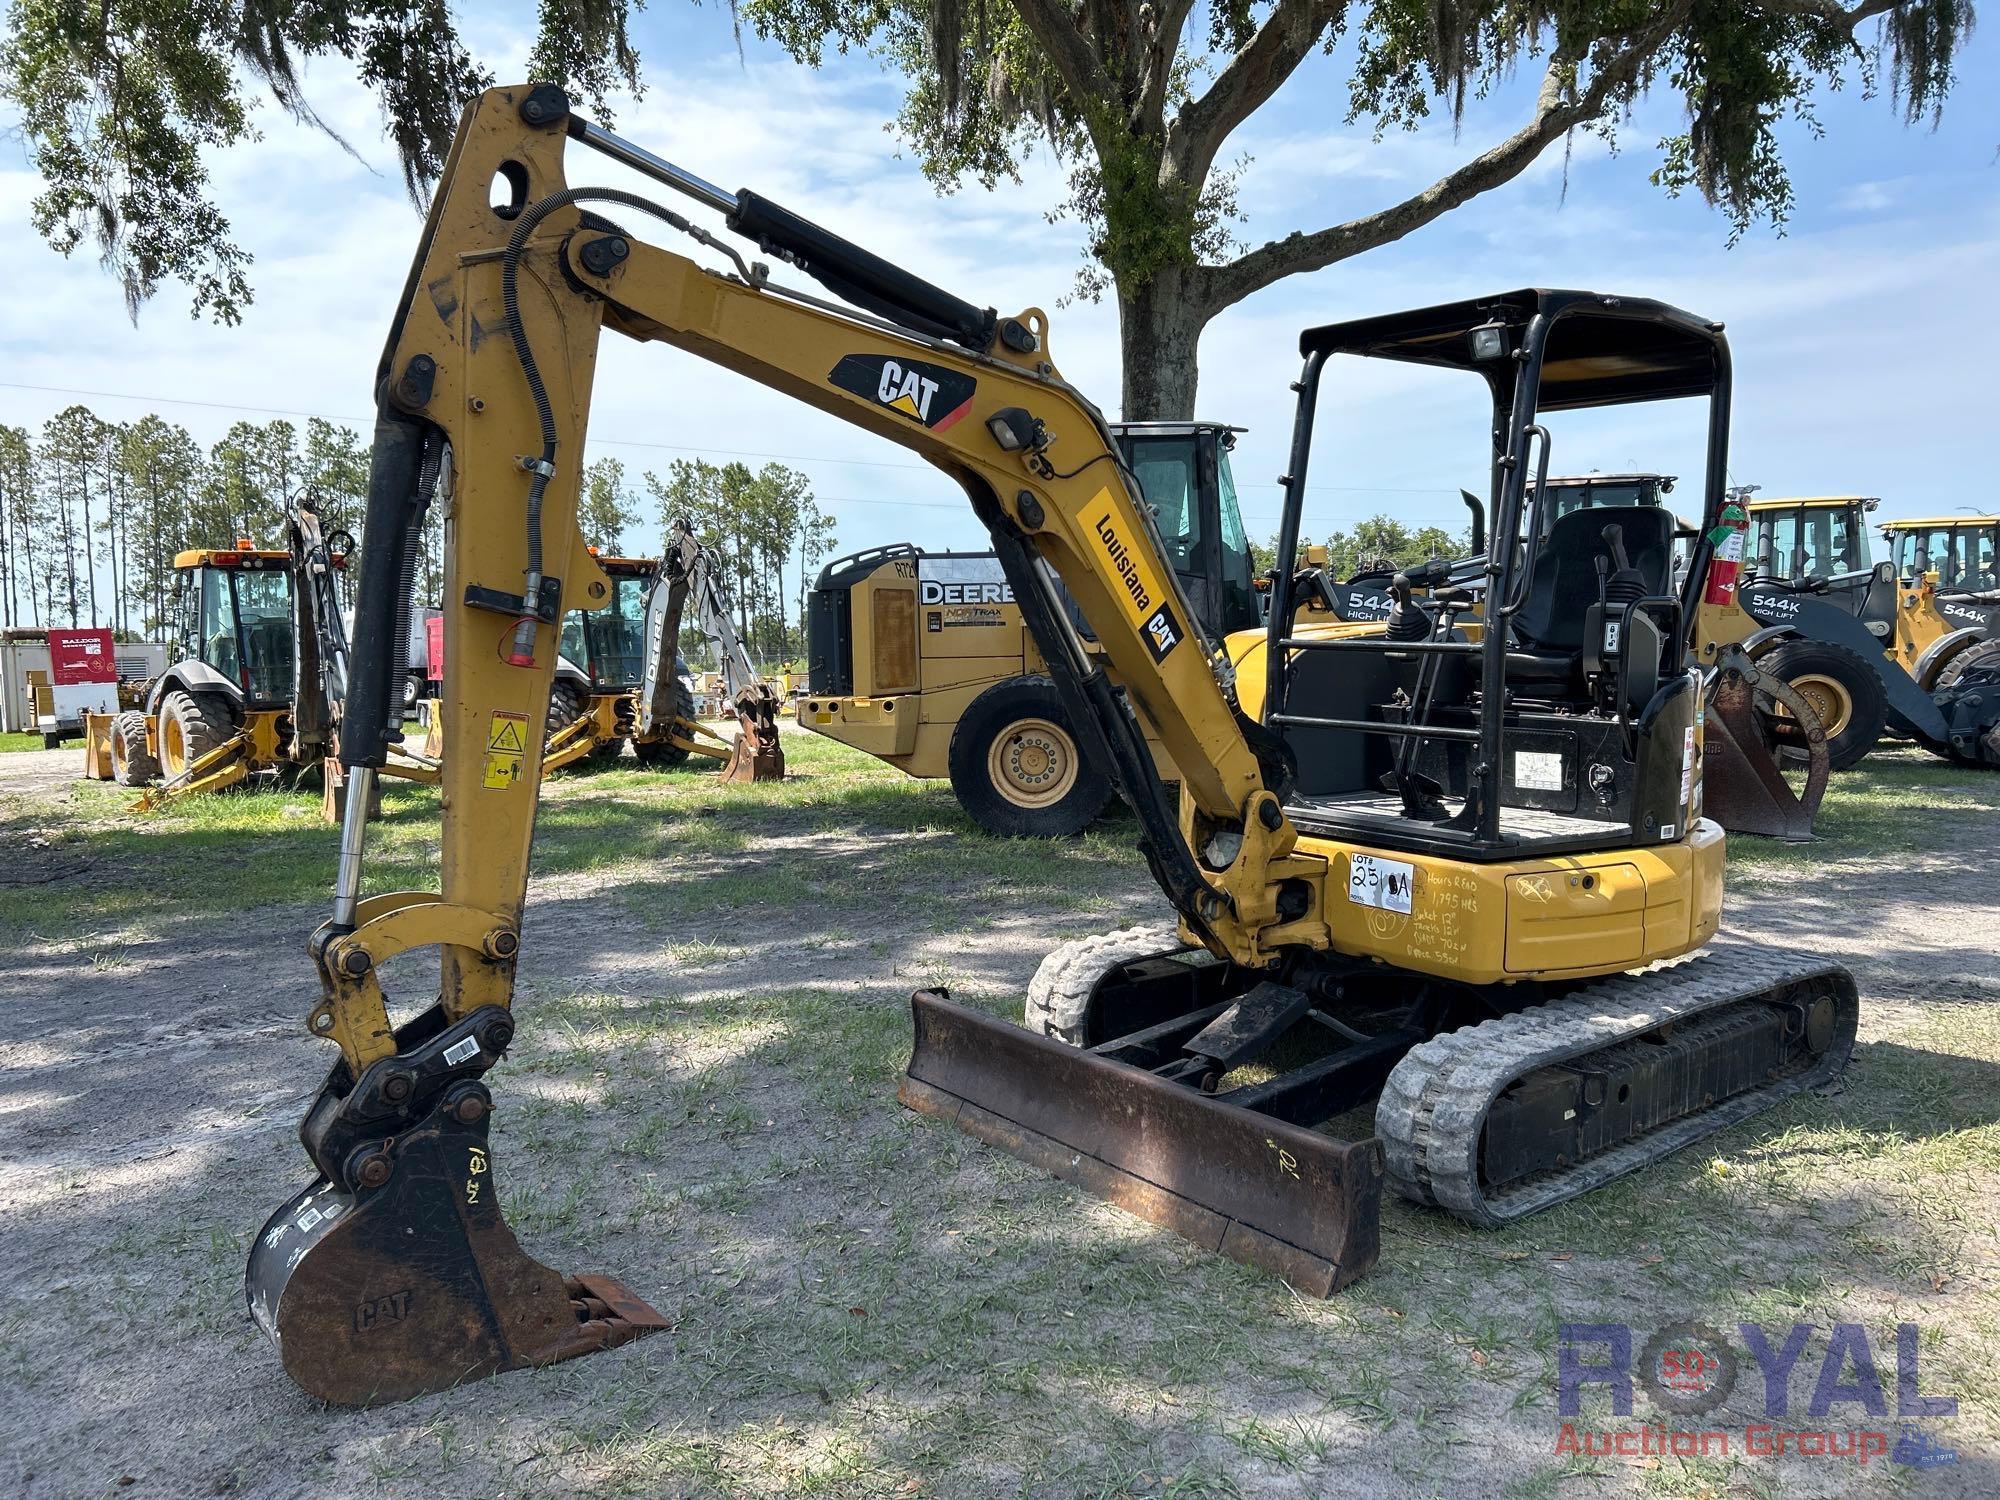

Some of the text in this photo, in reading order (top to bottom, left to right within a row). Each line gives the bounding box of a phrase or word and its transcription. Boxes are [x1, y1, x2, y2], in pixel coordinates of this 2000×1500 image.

[878, 360, 939, 422] CAT
[1095, 513, 1150, 612] Louisiana
[921, 582, 1017, 604] DEERE
[1349, 592, 1395, 612] 544
[1752, 594, 1801, 613] 544K
[1347, 611, 1374, 621] HIGH
[1753, 608, 1795, 620] HIGH LIFT
[1943, 603, 1987, 623] 544K
[1148, 613, 1176, 652] CAT
[646, 609, 662, 683] DEERE
[1353, 855, 1374, 865] LOT#
[353, 1291, 407, 1331] CAT
